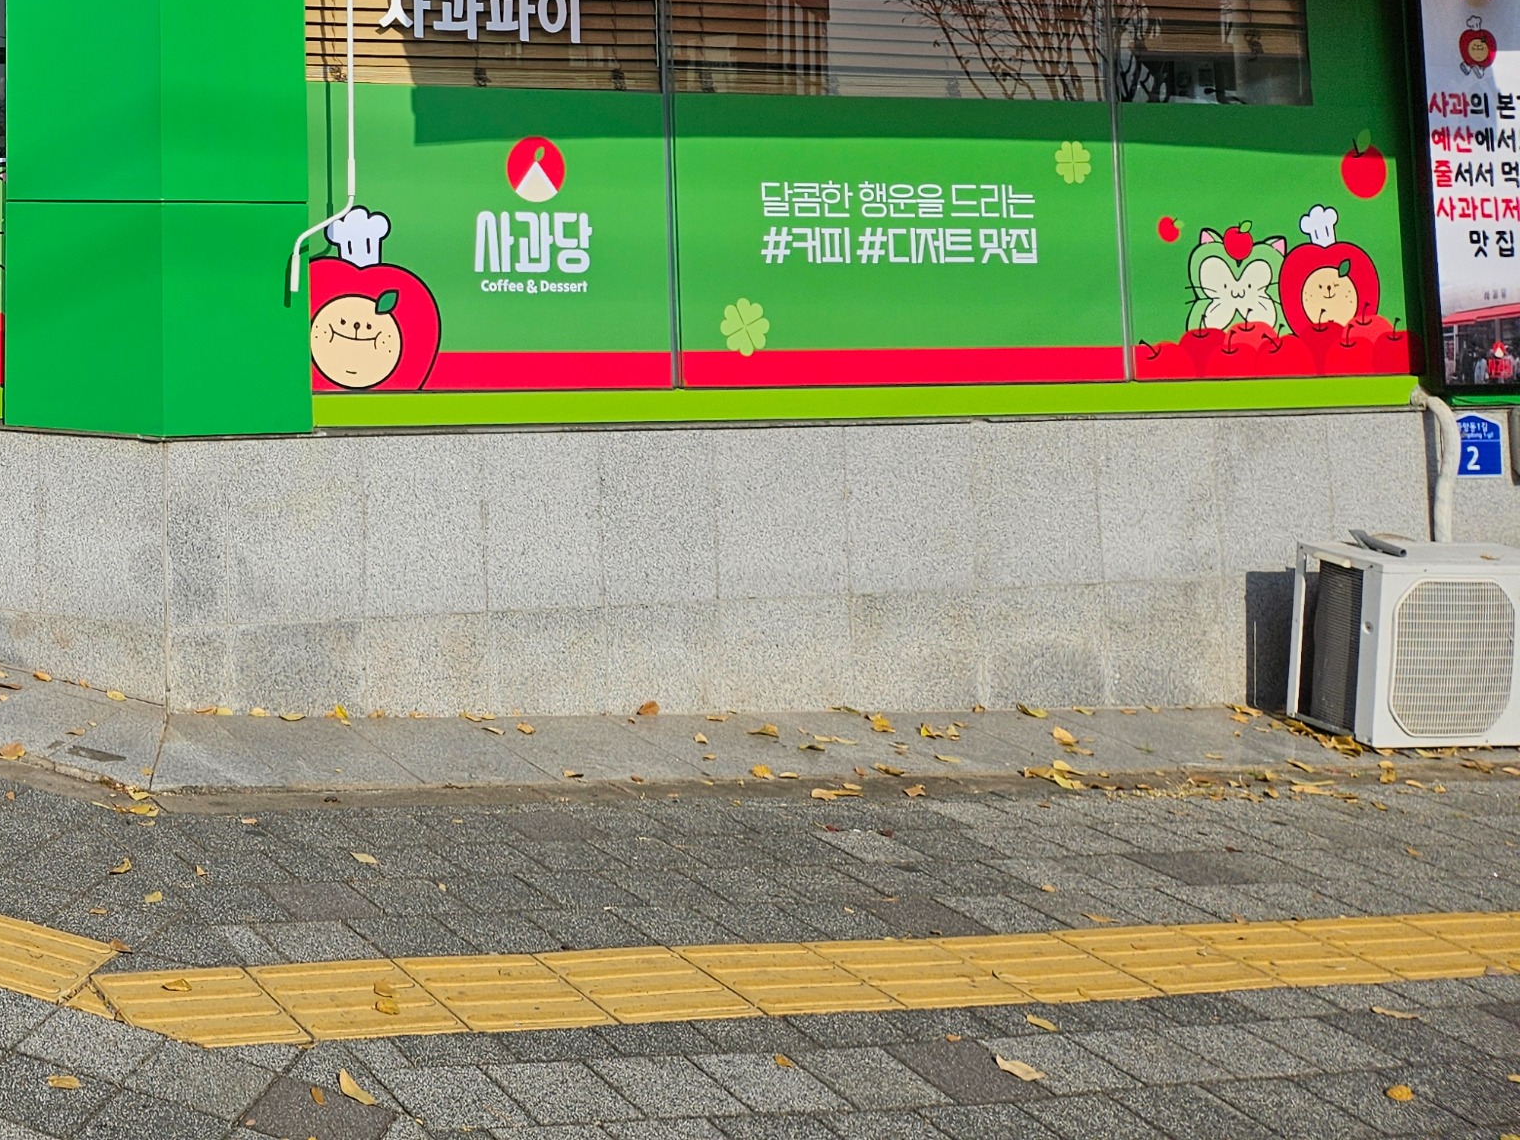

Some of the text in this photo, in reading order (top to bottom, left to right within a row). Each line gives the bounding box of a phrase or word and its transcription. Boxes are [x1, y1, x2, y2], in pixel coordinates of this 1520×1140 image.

[1429, 91, 1520, 120] 사과의 본
[1434, 160, 1494, 188] 줄서서
[761, 180, 1036, 219] 달콤한 행운을 드리는
[474, 210, 593, 274] 사과당
[761, 227, 1038, 264] #커피 #디저트 맛집
[480, 279, 588, 293] Coffee & Dessert
[1466, 445, 1481, 471] 2
